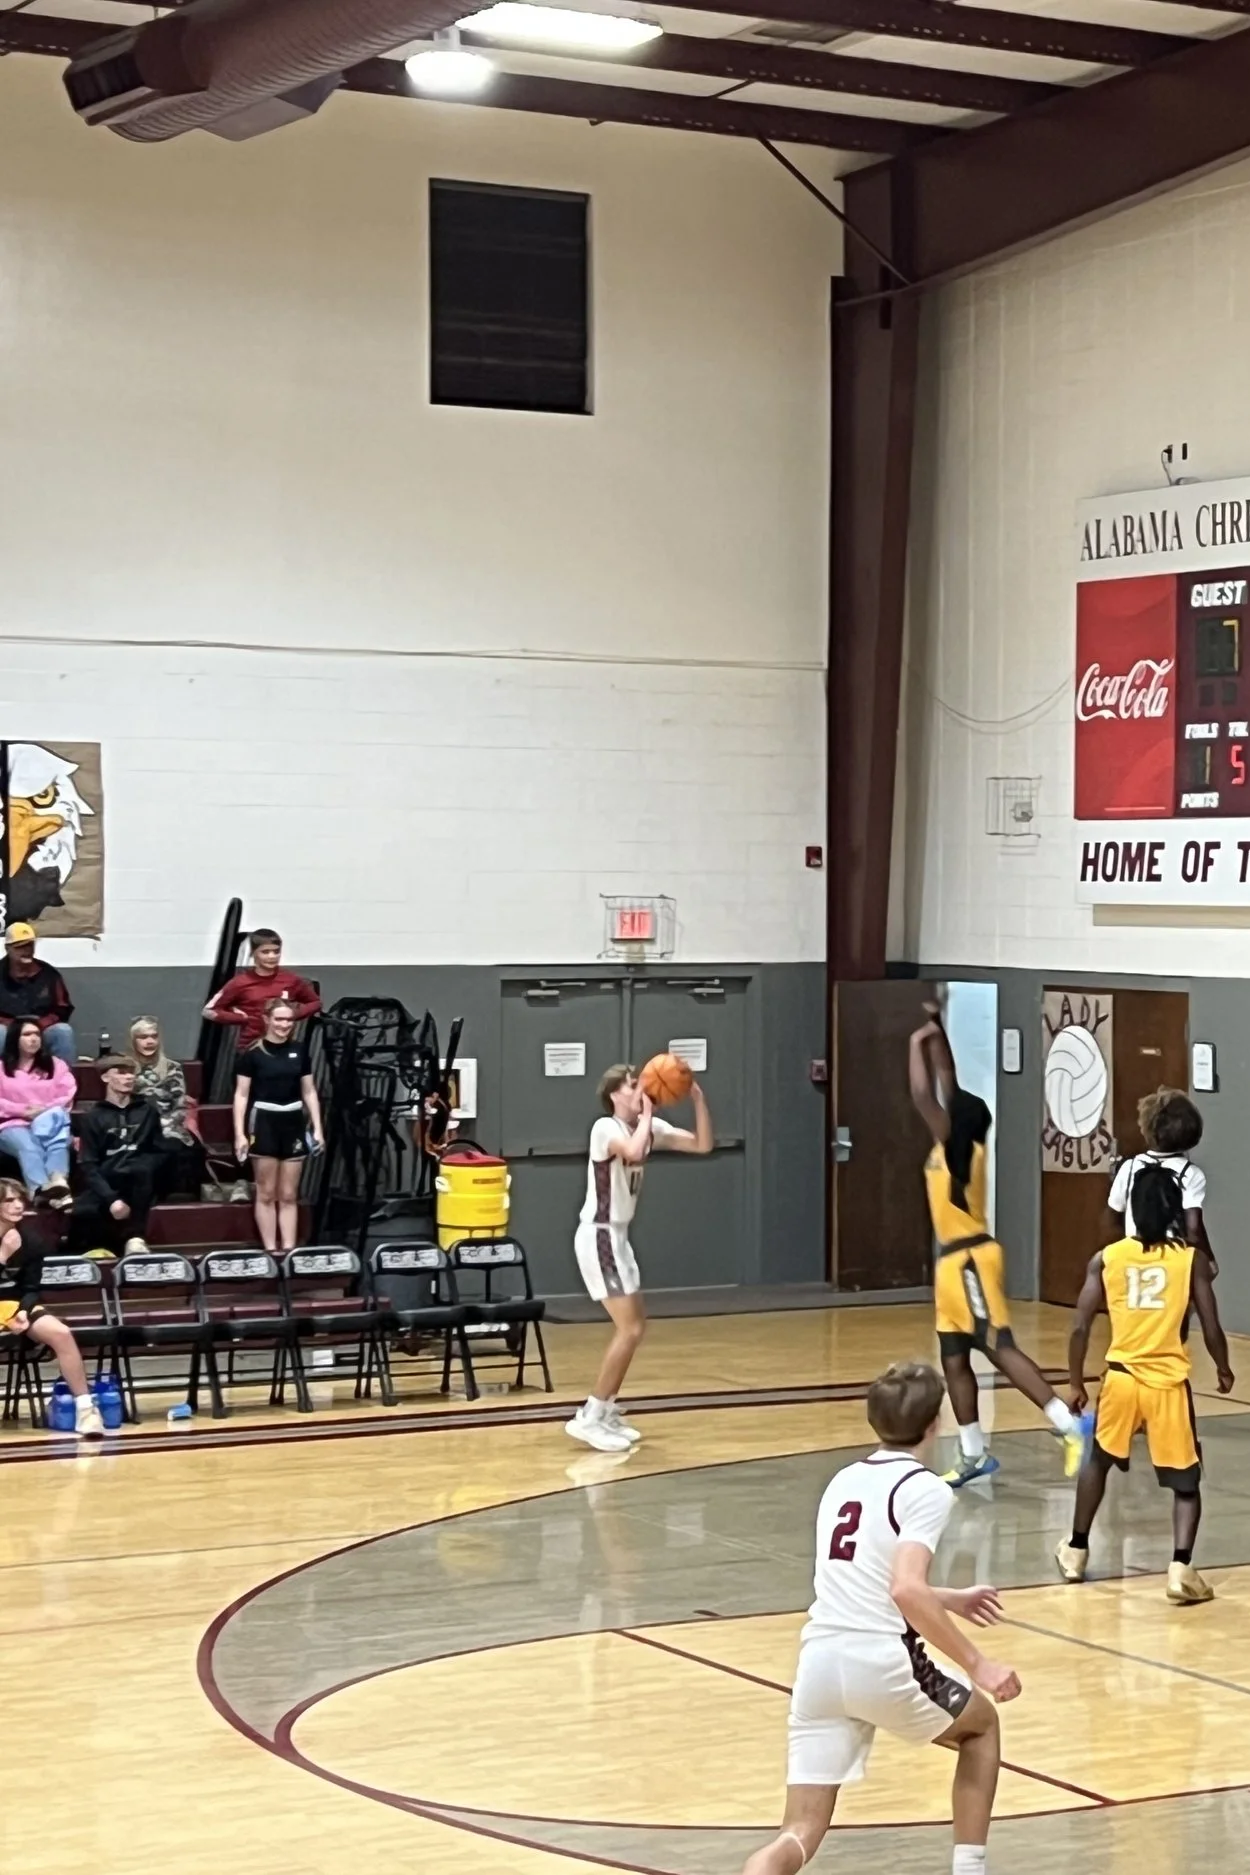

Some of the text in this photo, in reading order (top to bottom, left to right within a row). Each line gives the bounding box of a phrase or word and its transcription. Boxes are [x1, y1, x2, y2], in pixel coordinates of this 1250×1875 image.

[1081, 509, 1184, 562] ALABAMA
[1190, 580, 1247, 608] GUEST
[1077, 658, 1175, 721] Coca-Cola
[1231, 744, 1246, 785] 5
[1080, 841, 1166, 883] HOME
[1181, 840, 1221, 884] OF
[1043, 994, 1110, 1037] LADY
[1041, 1118, 1113, 1171] EAGLES
[1125, 1265, 1168, 1310] 12
[828, 1500, 863, 1562] 2
